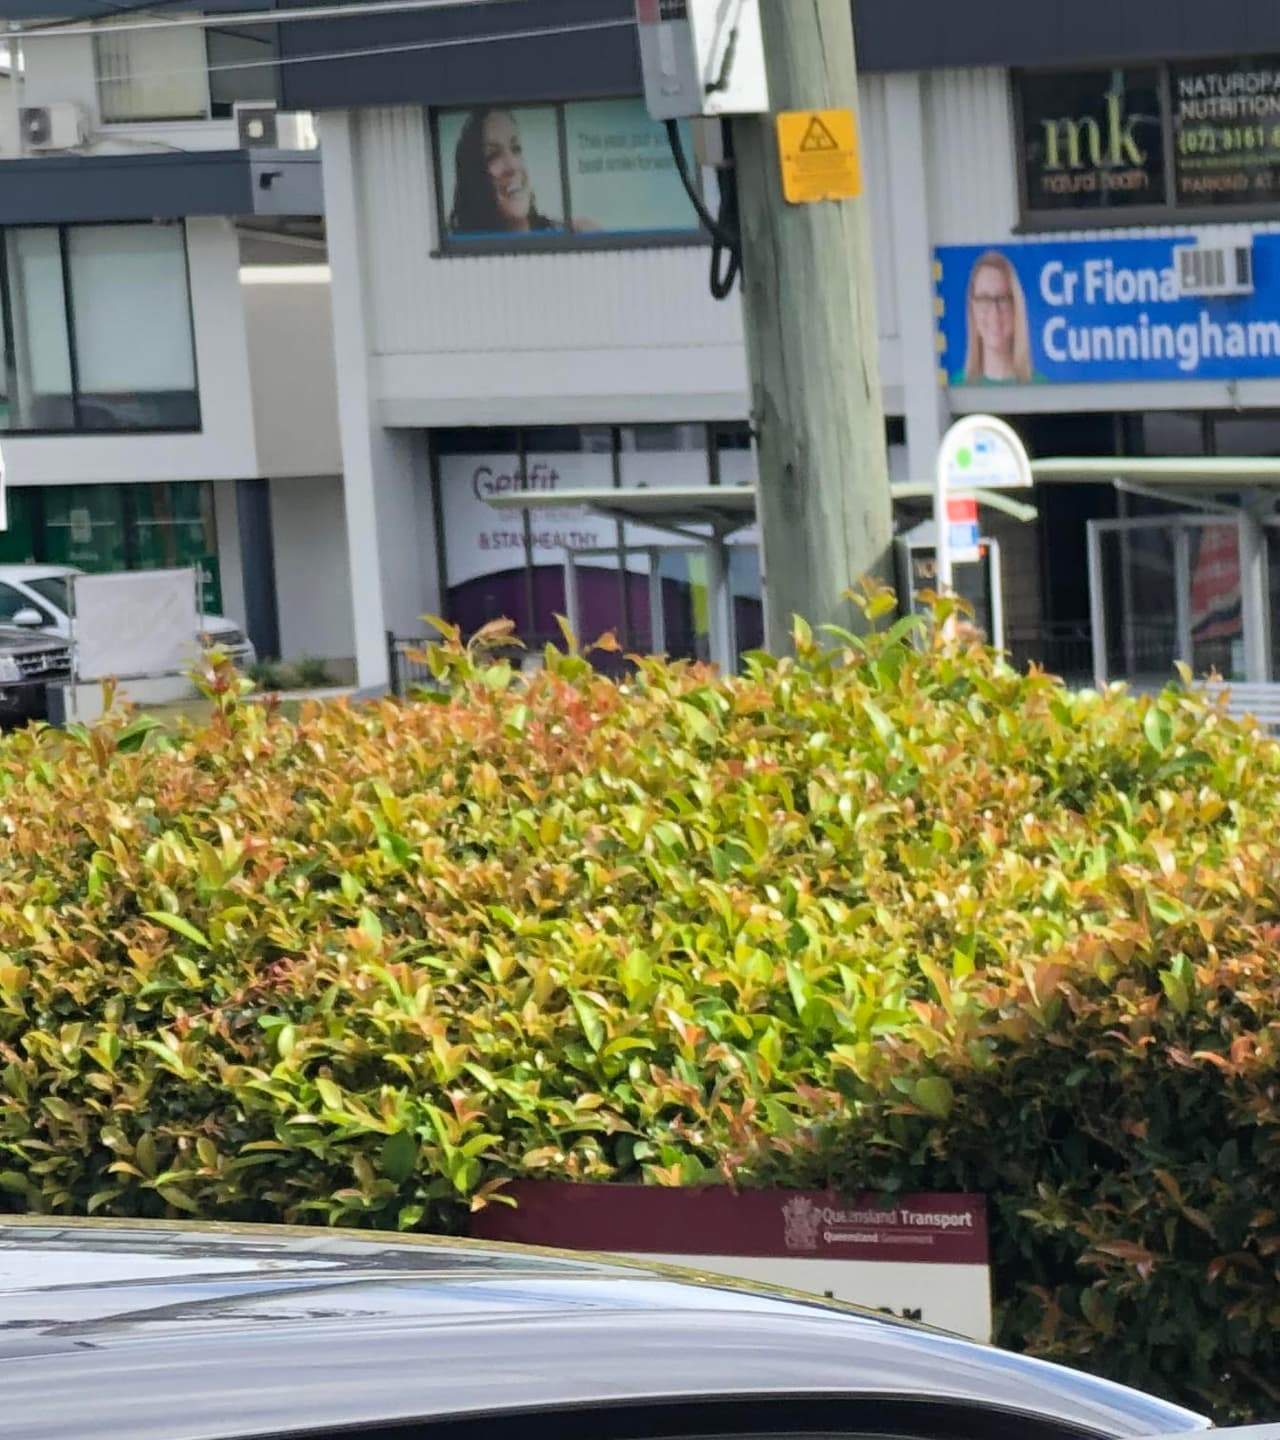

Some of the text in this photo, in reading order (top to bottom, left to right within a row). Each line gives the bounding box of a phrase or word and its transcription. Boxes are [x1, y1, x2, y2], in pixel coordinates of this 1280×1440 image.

[1041, 91, 1148, 170] mk
[1040, 257, 1180, 306] Cr Fiona
[901, 1209, 973, 1229] Transport
